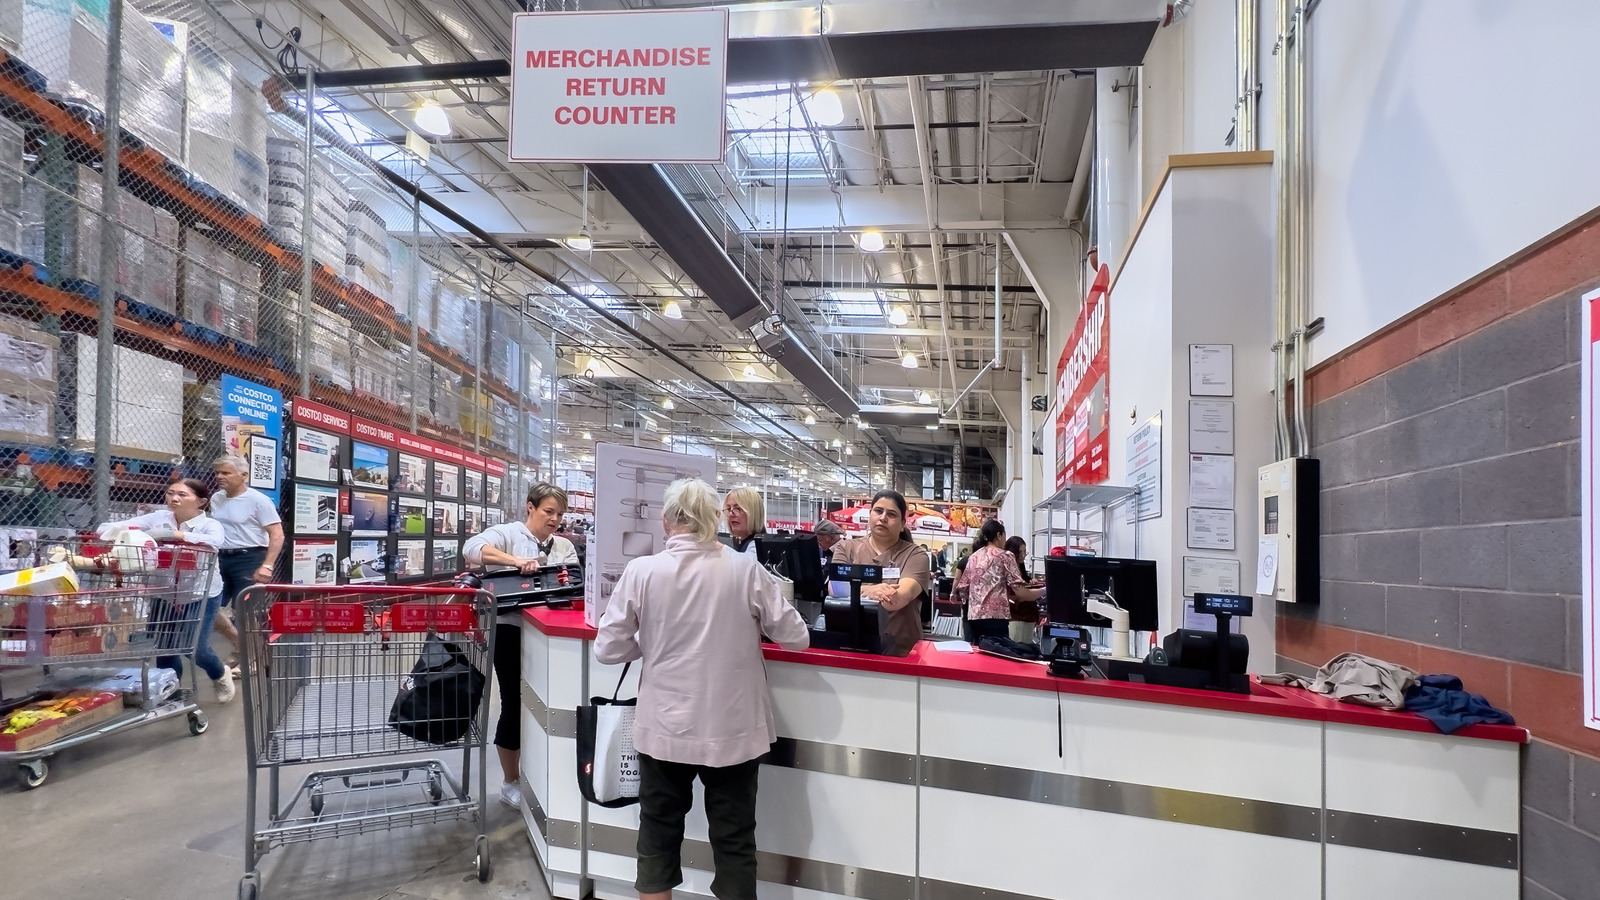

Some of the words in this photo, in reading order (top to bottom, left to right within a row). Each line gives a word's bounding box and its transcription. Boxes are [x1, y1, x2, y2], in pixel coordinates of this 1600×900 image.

[525, 47, 711, 68] MERCHANDISE
[566, 77, 666, 96] RETURN
[554, 106, 676, 125] COUNTER
[1056, 292, 1106, 420] MEMBERSHIP
[228, 393, 278, 414] CONNECTION
[243, 387, 273, 403] COSTCO
[238, 406, 269, 421] ONLINE!
[297, 405, 322, 422] COSTCO
[322, 413, 348, 429] SERVICES
[356, 422, 377, 437] COSTCO
[377, 428, 395, 442] TRAVEL
[400, 438, 420, 448] INSTALLATION
[420, 444, 432, 452] SERVICES
[776, 522, 805, 531] PHARMACY
